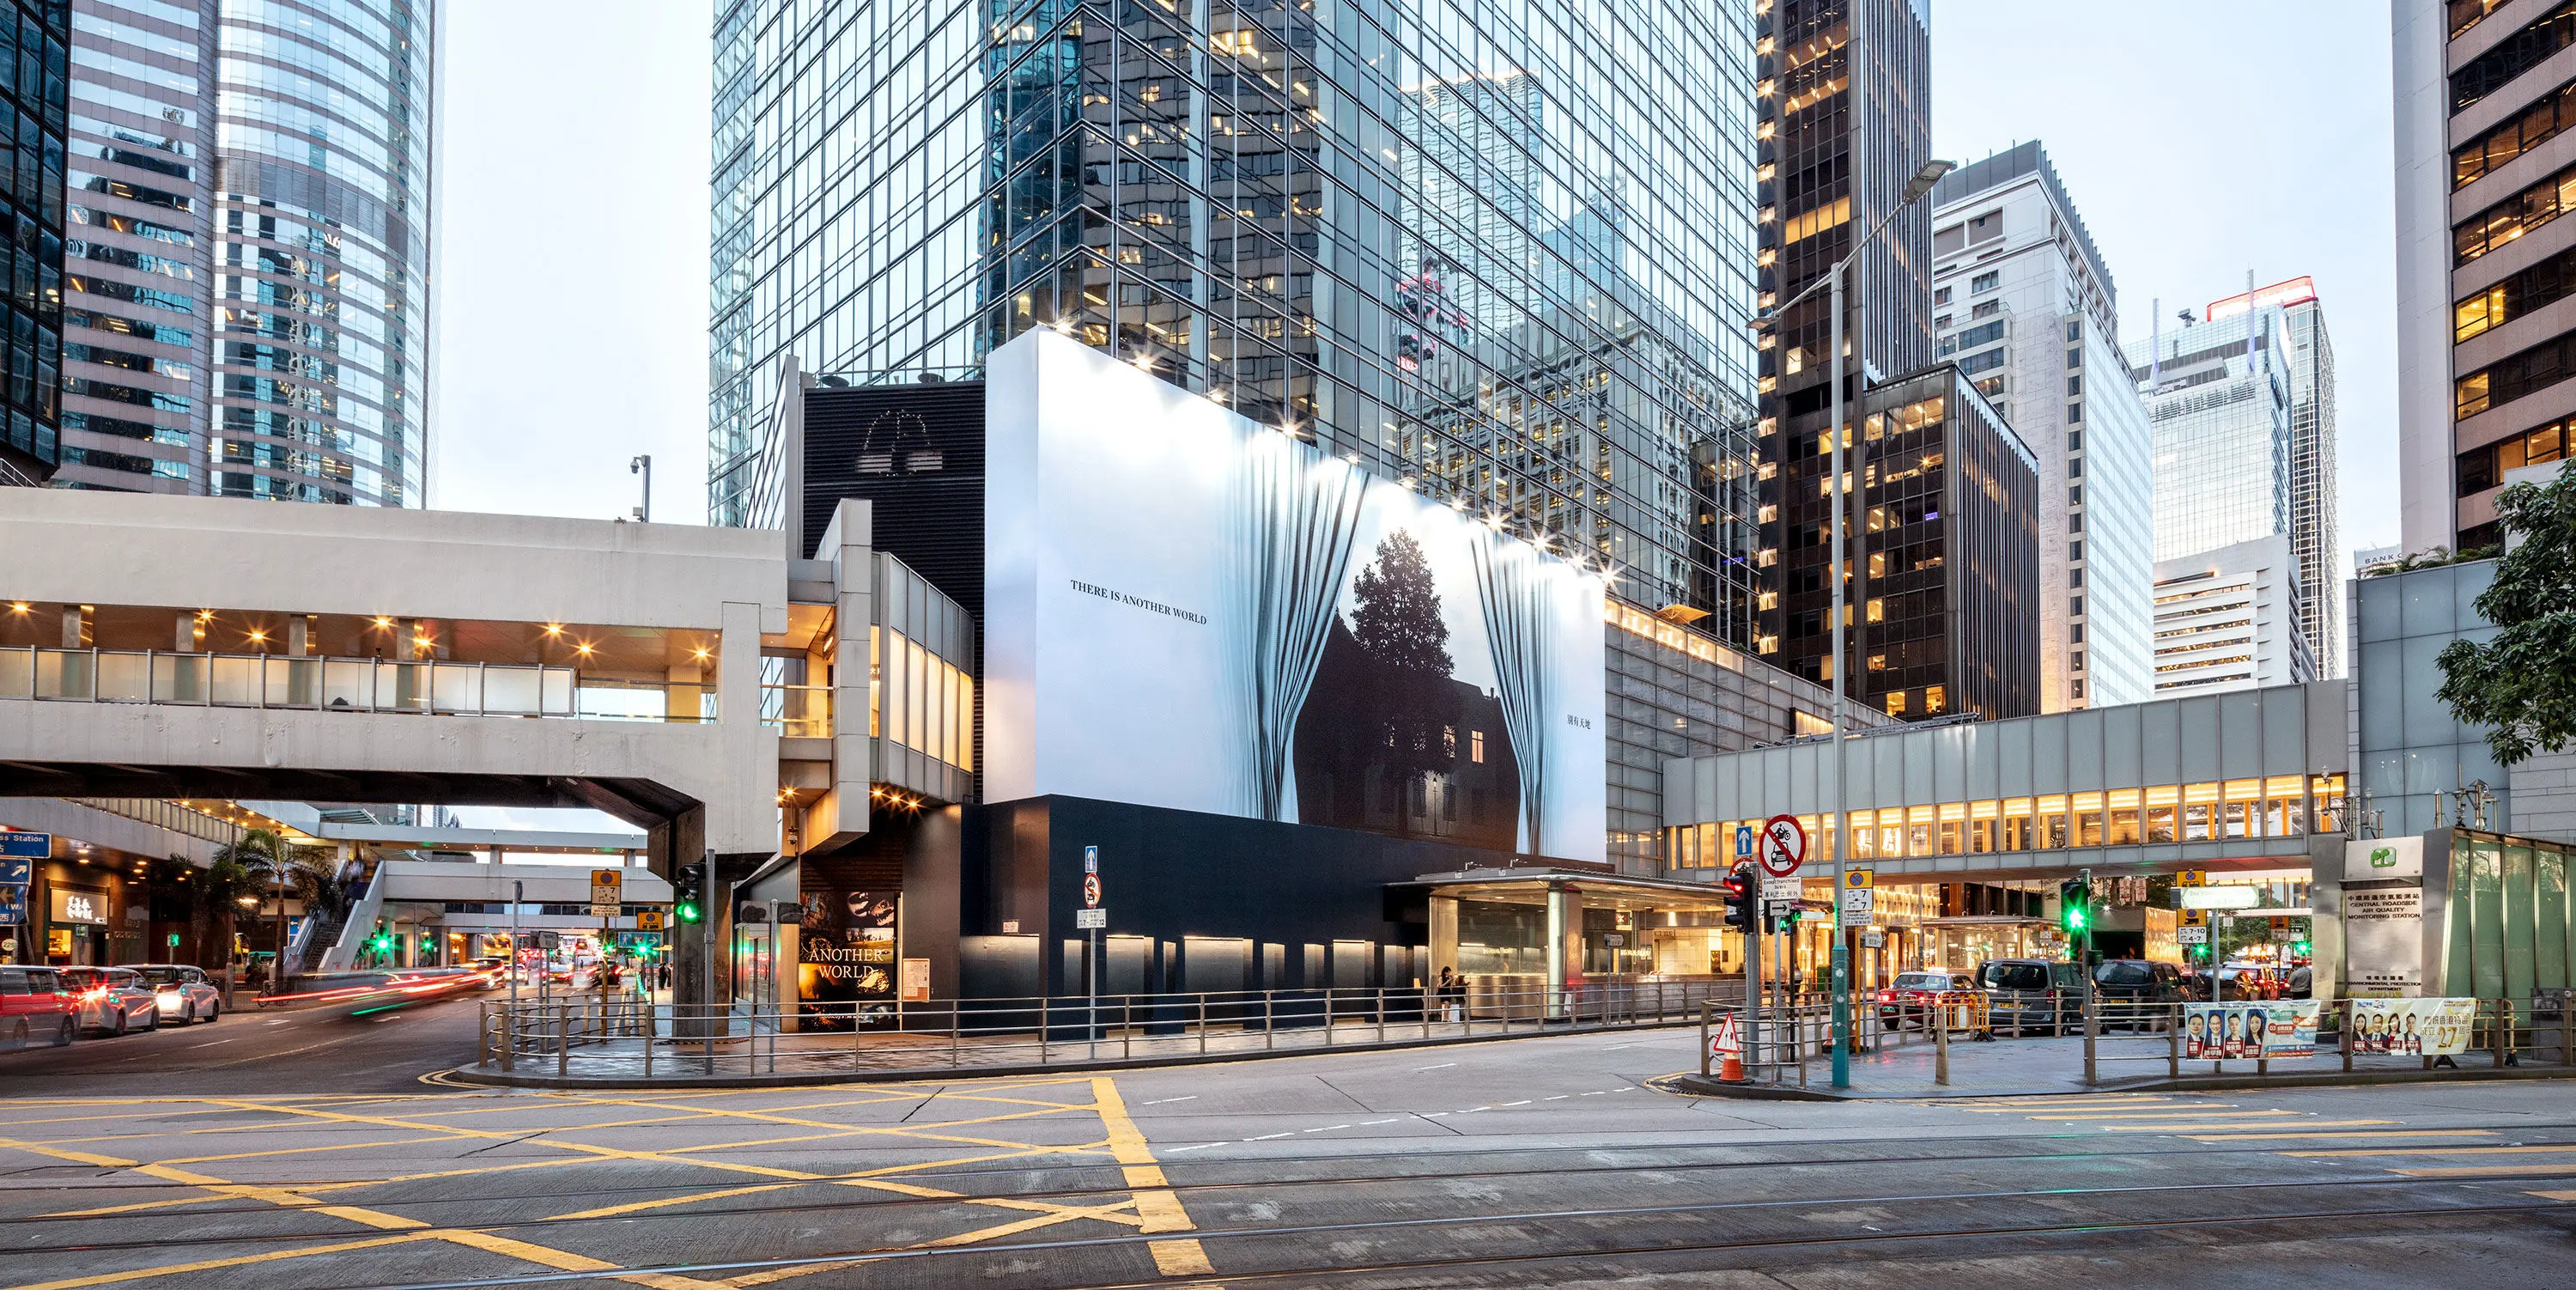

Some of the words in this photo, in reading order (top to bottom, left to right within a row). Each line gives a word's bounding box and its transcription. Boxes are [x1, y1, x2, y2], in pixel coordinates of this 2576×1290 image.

[2365, 554, 2394, 564] BANK
[1071, 579, 1108, 599] THERE
[1111, 590, 1121, 601] IS
[1121, 594, 1171, 616] ANOTHER
[1172, 607, 1207, 625] WORLD
[1567, 714, 1590, 729] 別有天地
[809, 948, 884, 962] ANOTHER
[817, 965, 873, 978] WORLD
[2438, 1026, 2458, 1048] 27
